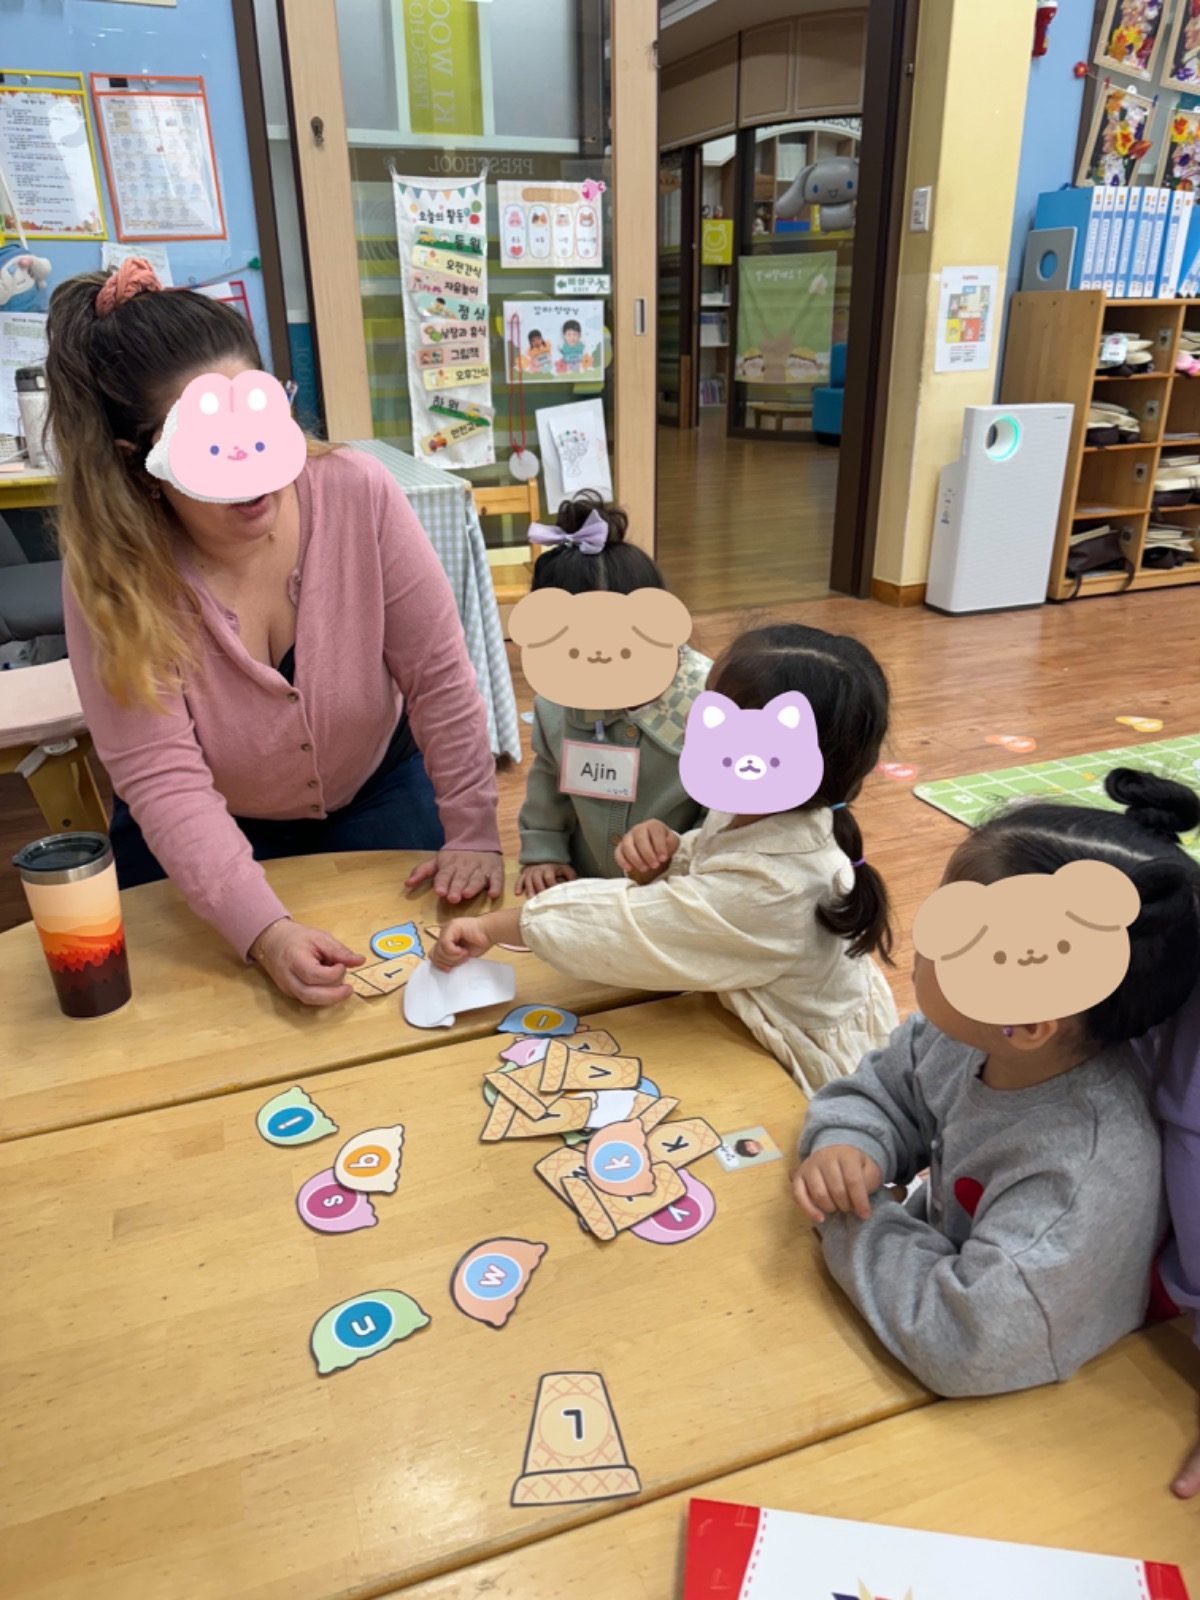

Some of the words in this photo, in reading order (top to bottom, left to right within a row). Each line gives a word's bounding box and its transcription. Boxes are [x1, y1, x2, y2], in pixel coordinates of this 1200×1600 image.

[419, 209, 443, 225] 오늘의
[446, 259, 482, 279] 오전간식
[450, 421, 483, 439] 안전교
[580, 761, 617, 782] Ajin
[588, 1064, 612, 1079] V
[660, 1135, 690, 1153] K
[348, 1152, 381, 1169] b
[323, 1194, 344, 1208] s
